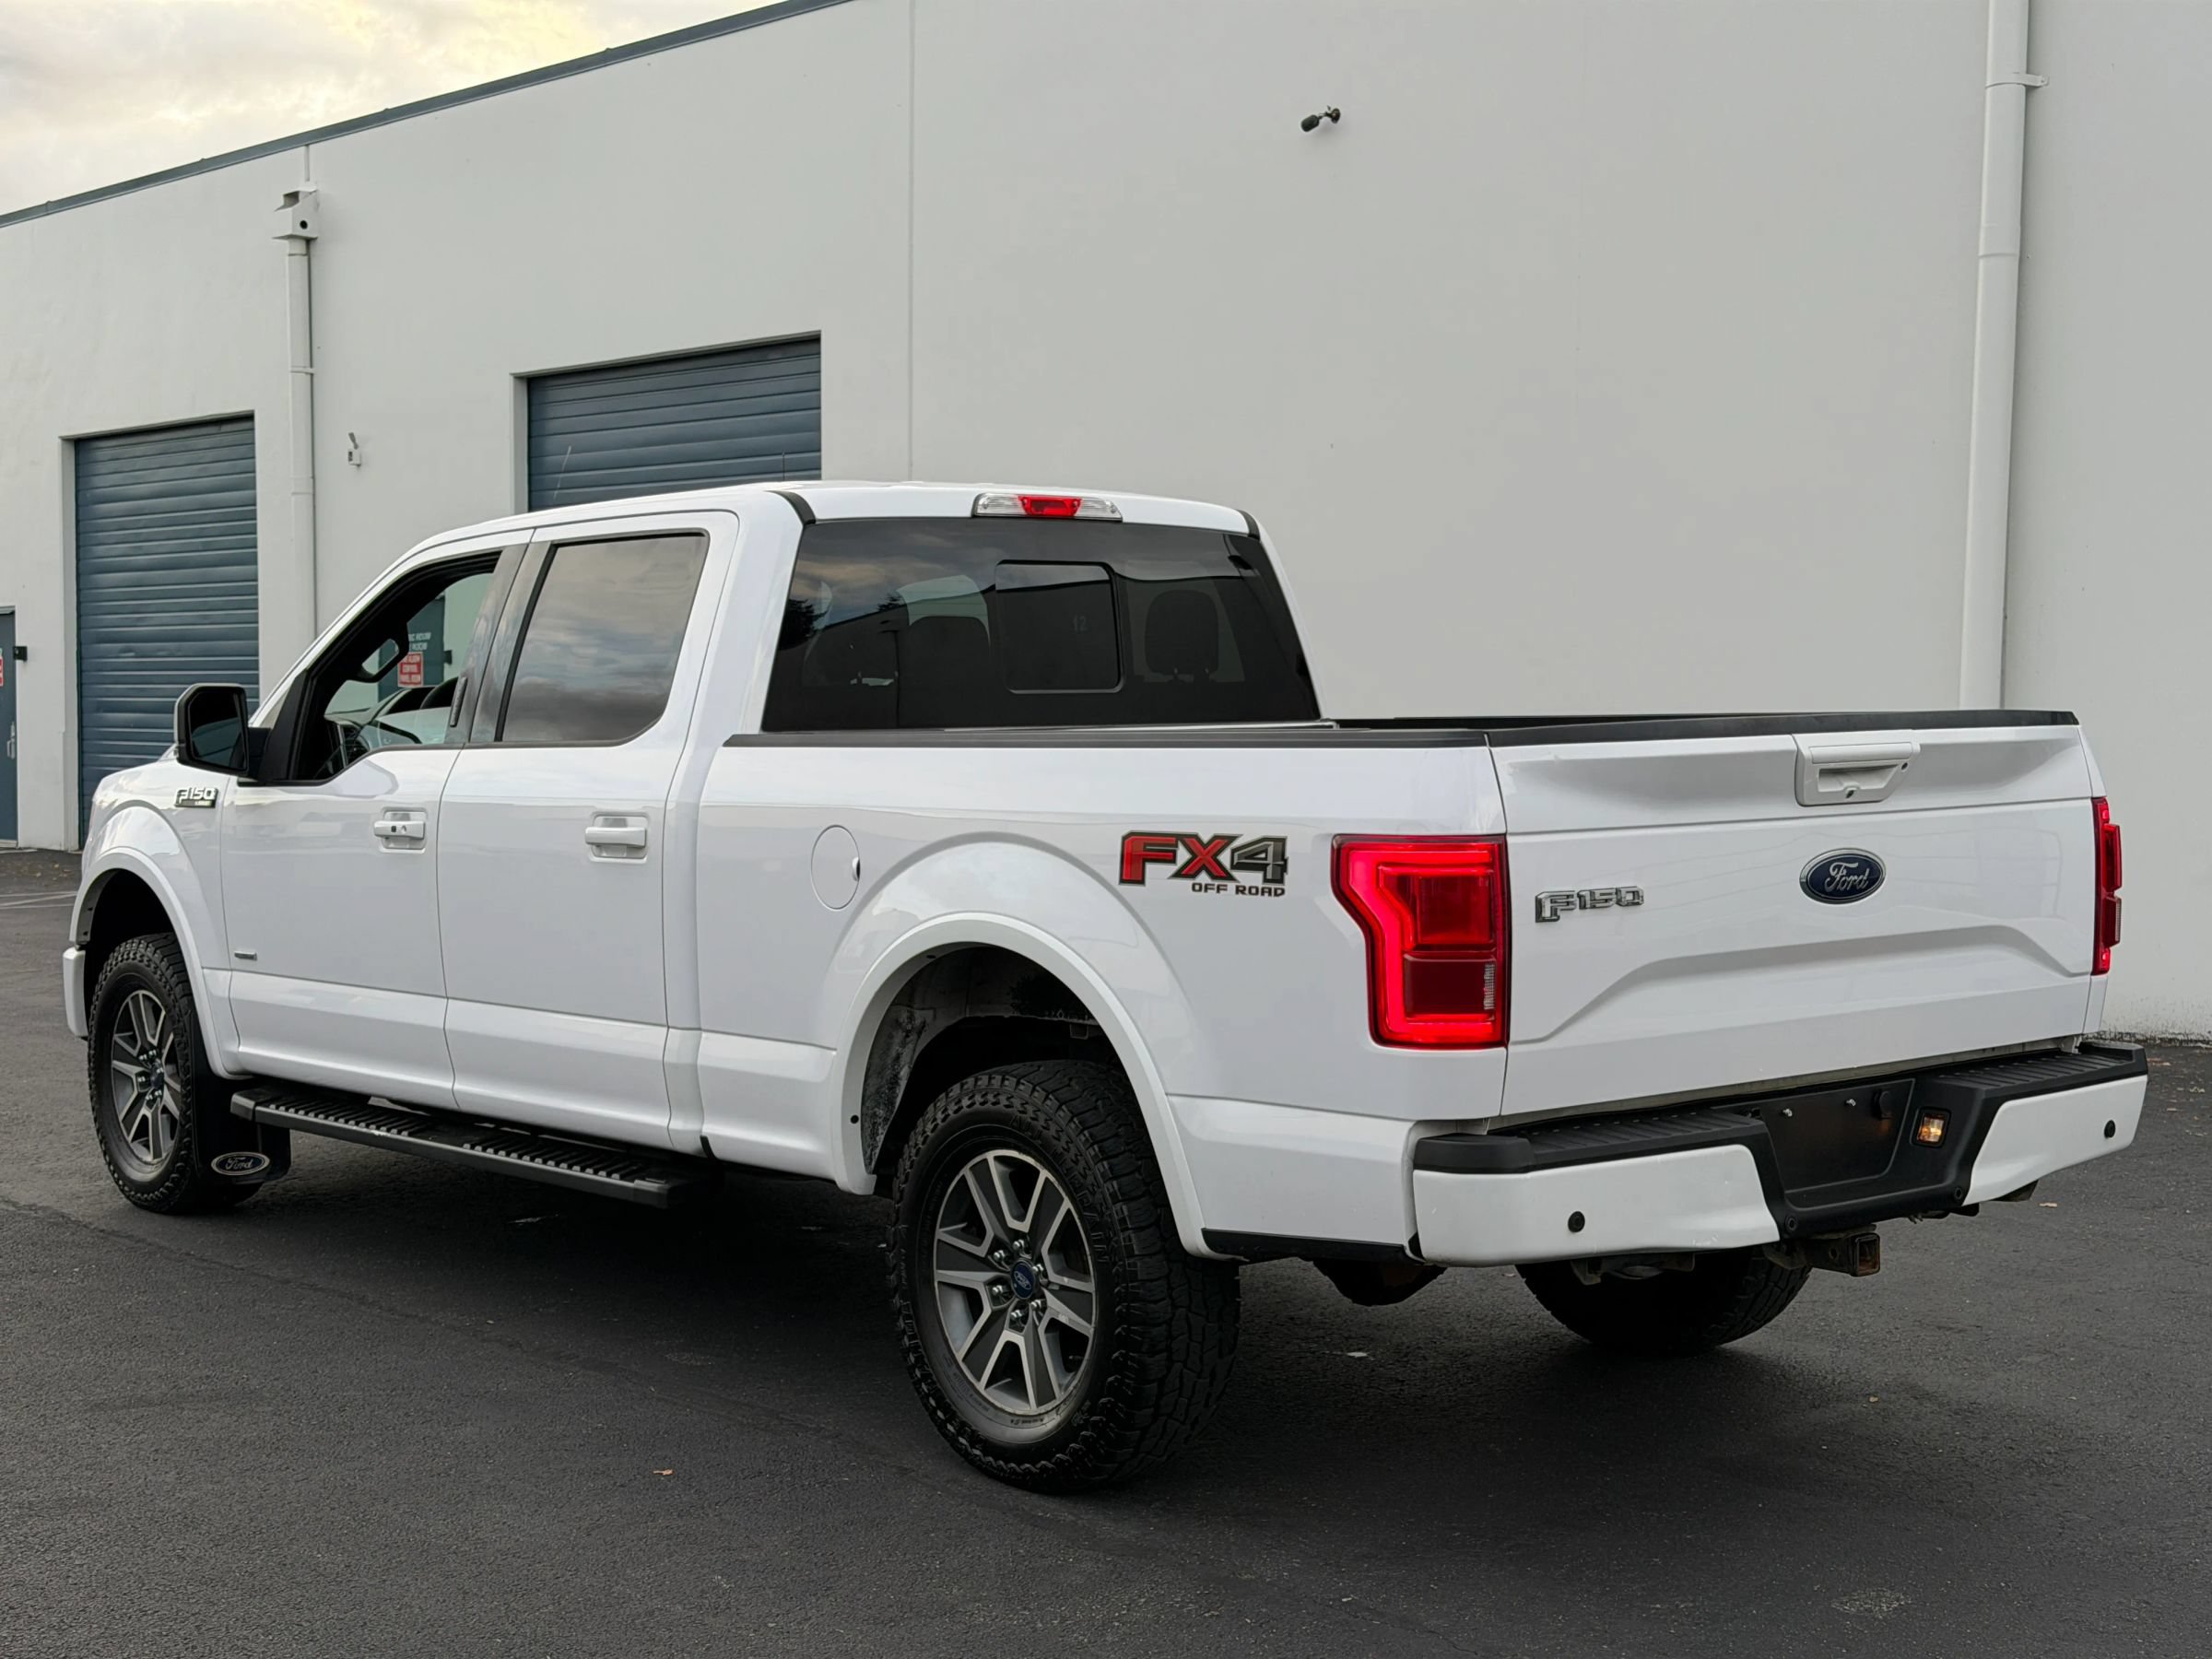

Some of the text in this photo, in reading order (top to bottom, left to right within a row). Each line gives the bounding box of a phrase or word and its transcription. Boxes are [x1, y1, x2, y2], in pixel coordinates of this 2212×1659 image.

[175, 787, 218, 806] F150
[1118, 830, 1289, 887] FX4
[1191, 882, 1286, 898] OFF ROAD
[1825, 862, 1870, 892] Ford
[1535, 885, 1644, 923] F150
